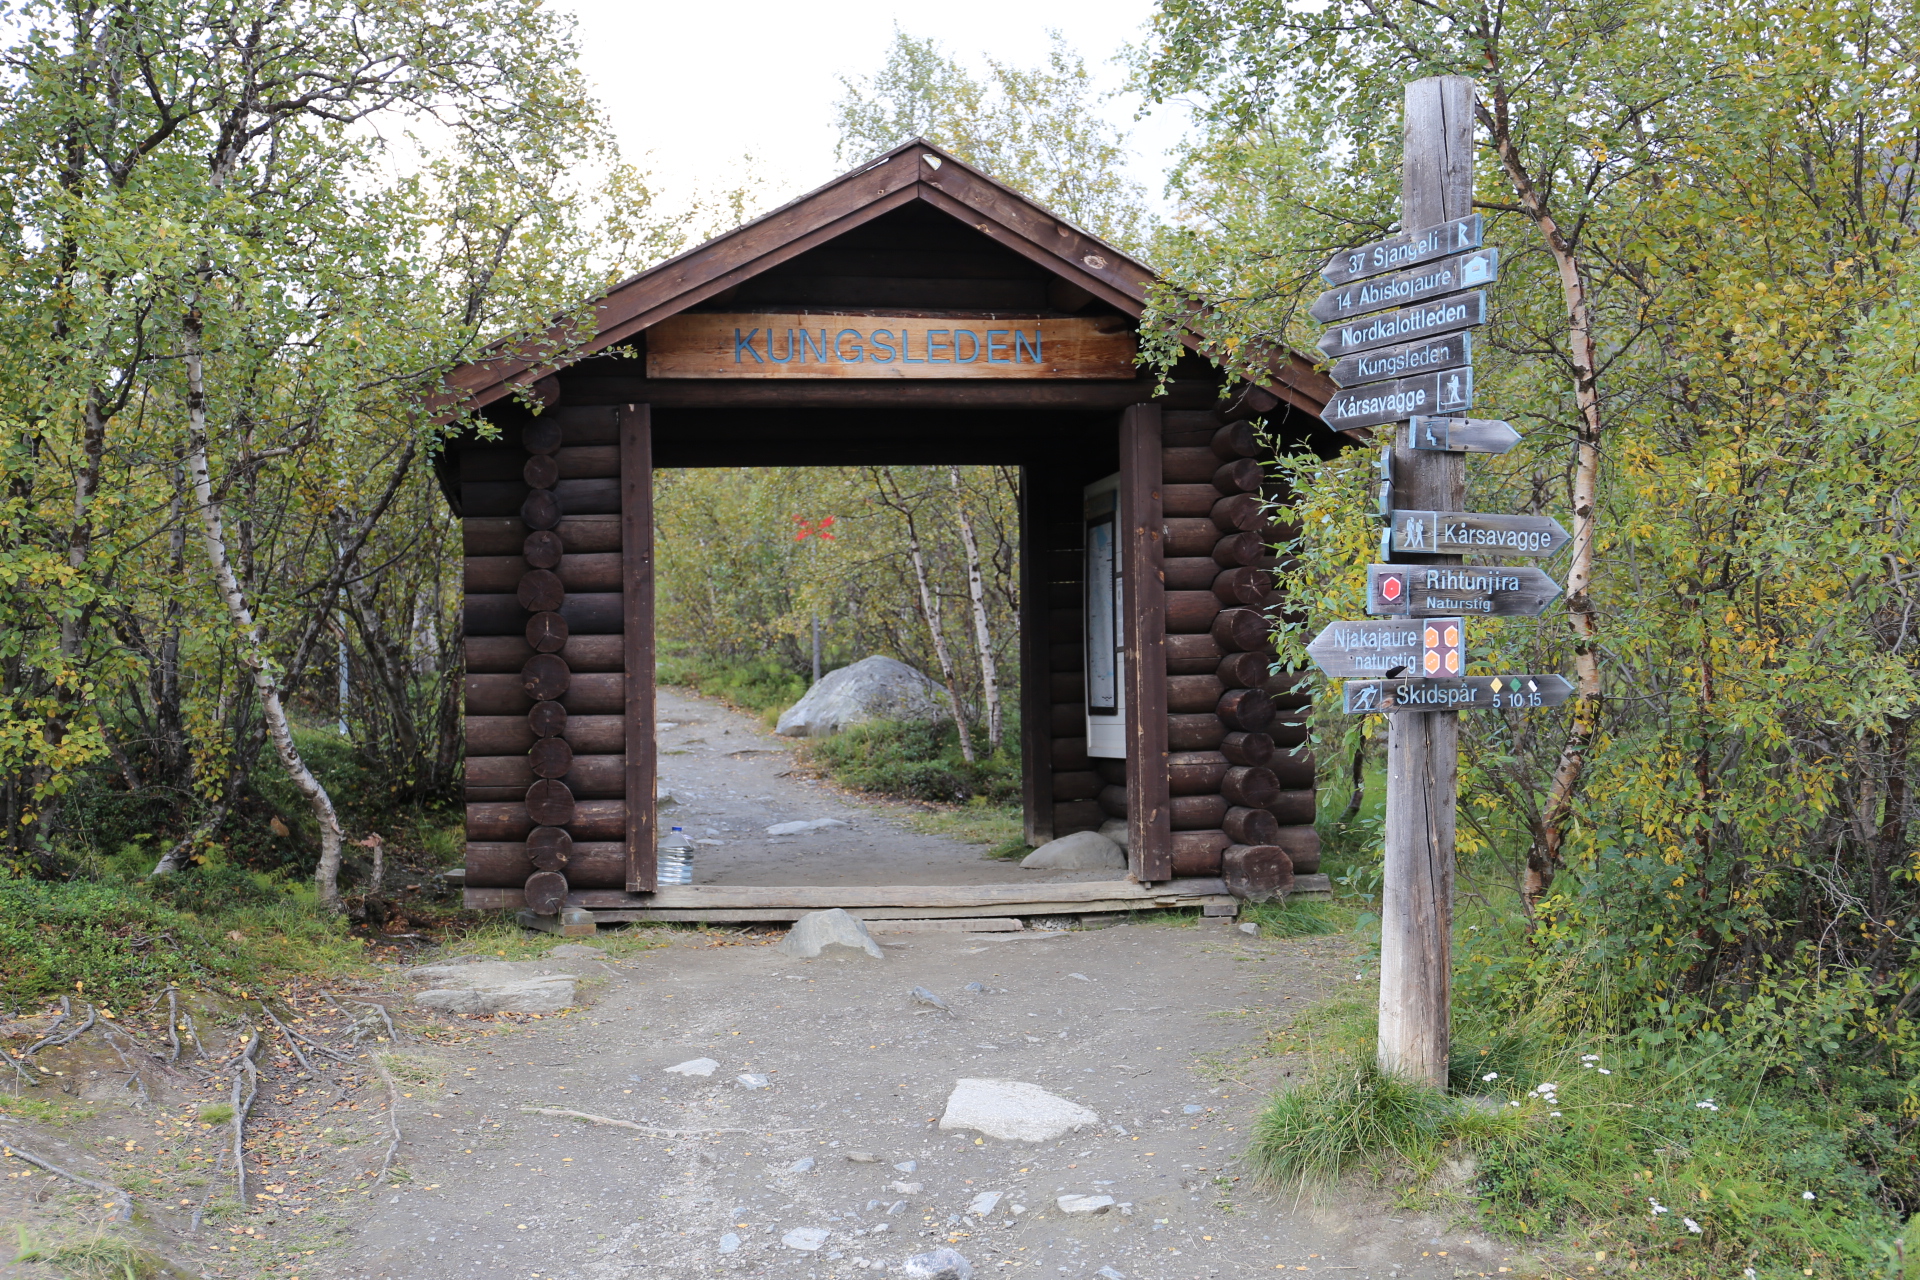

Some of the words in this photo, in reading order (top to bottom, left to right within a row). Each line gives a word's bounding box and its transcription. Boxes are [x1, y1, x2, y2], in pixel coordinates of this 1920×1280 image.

[1348, 253, 1366, 274] 37
[1373, 231, 1439, 267] Sjangeli
[1336, 292, 1352, 311] 14
[1360, 269, 1451, 305] Abiskojaure
[1341, 303, 1466, 347] Nordkalottleden
[734, 328, 1043, 365] KUNGSLEDEN
[1358, 346, 1449, 377] Kungsleden
[1337, 388, 1426, 419] Kårsavagge
[1444, 523, 1551, 551] Kårsavagge
[1426, 569, 1519, 594] Rihtunjira
[1426, 597, 1491, 612] Naturstig
[1334, 628, 1417, 651] Njakajaure
[1355, 653, 1416, 674] naturstig
[1396, 683, 1476, 708] Skidspår
[1492, 694, 1501, 708] 5
[1508, 693, 1523, 707] 10
[1528, 693, 1541, 707] 15
